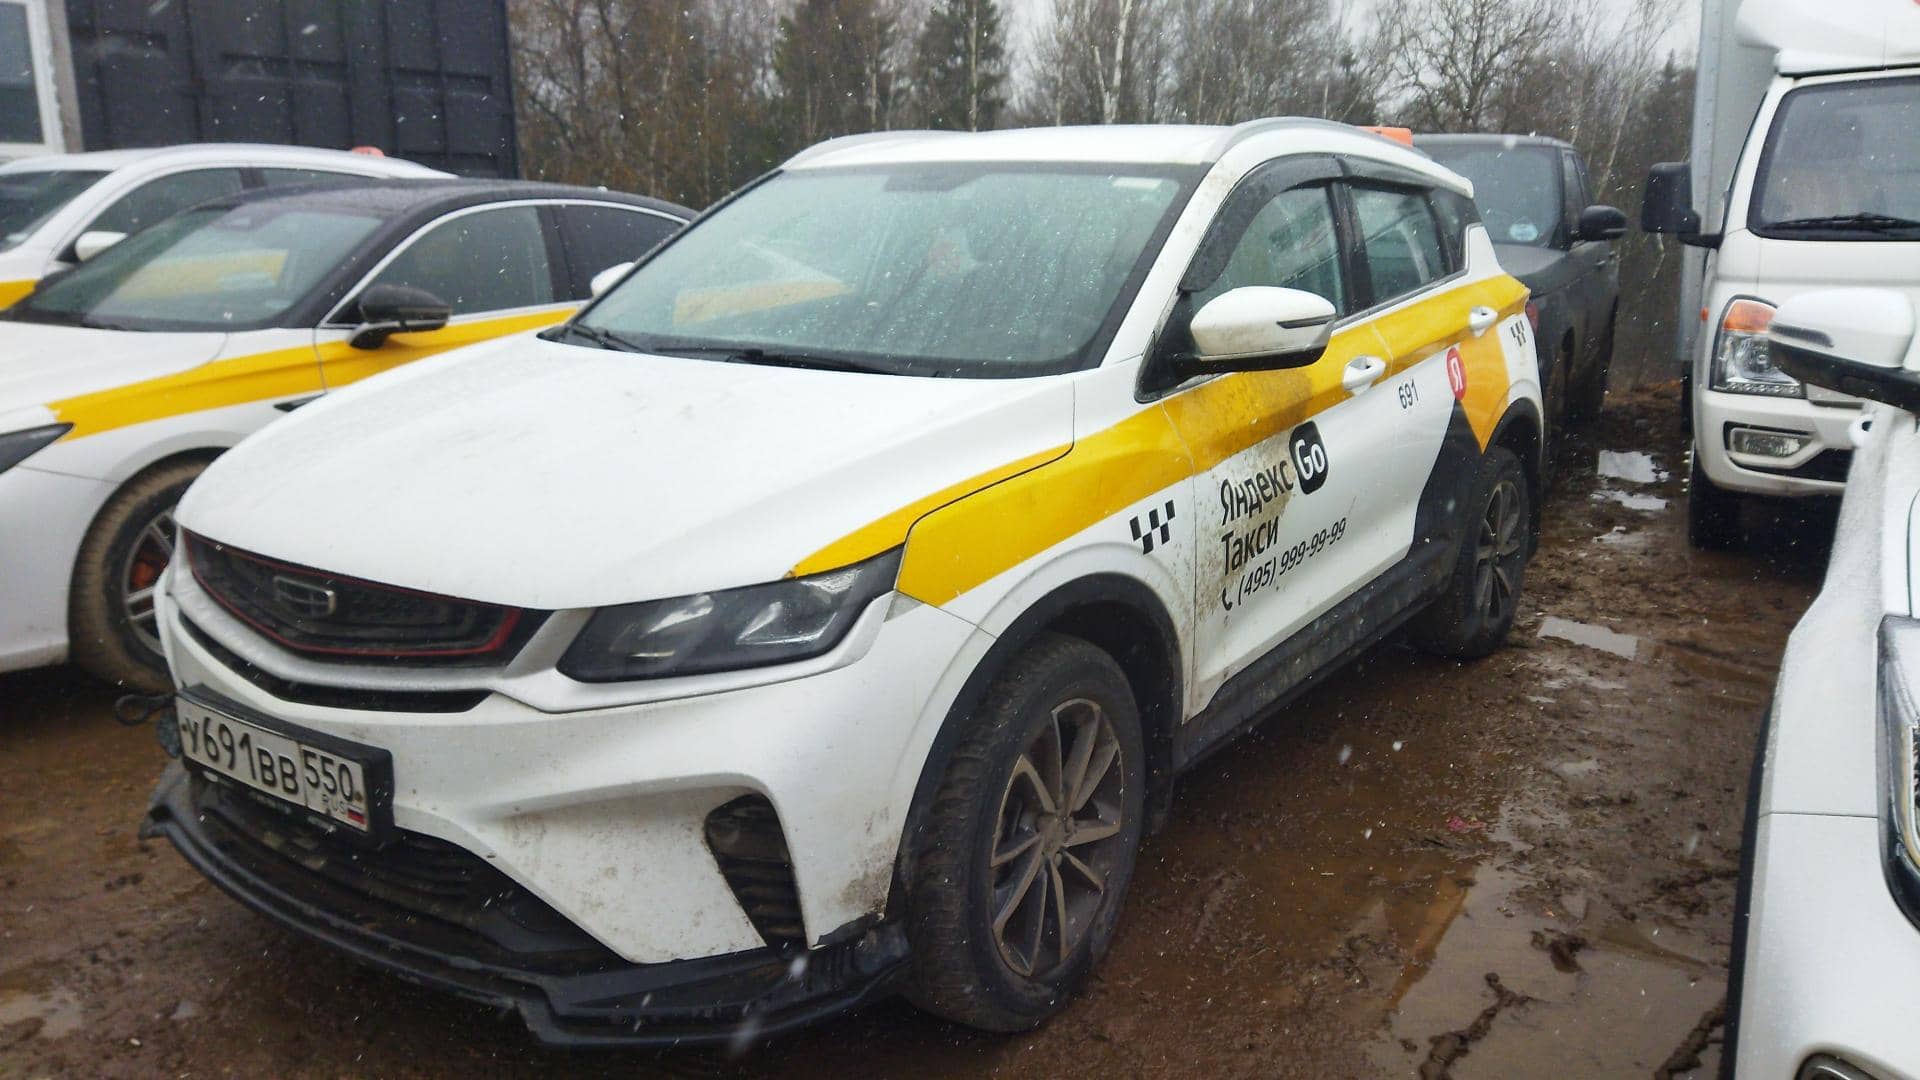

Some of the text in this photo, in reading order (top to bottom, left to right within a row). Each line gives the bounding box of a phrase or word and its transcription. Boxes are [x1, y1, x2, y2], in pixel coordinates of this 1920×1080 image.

[1398, 376, 1419, 410] 691
[1449, 356, 1464, 392] Я
[1220, 439, 1326, 526] Яндекс Go
[1221, 515, 1280, 577] Такси
[1237, 517, 1347, 606] (495) 999-99-99
